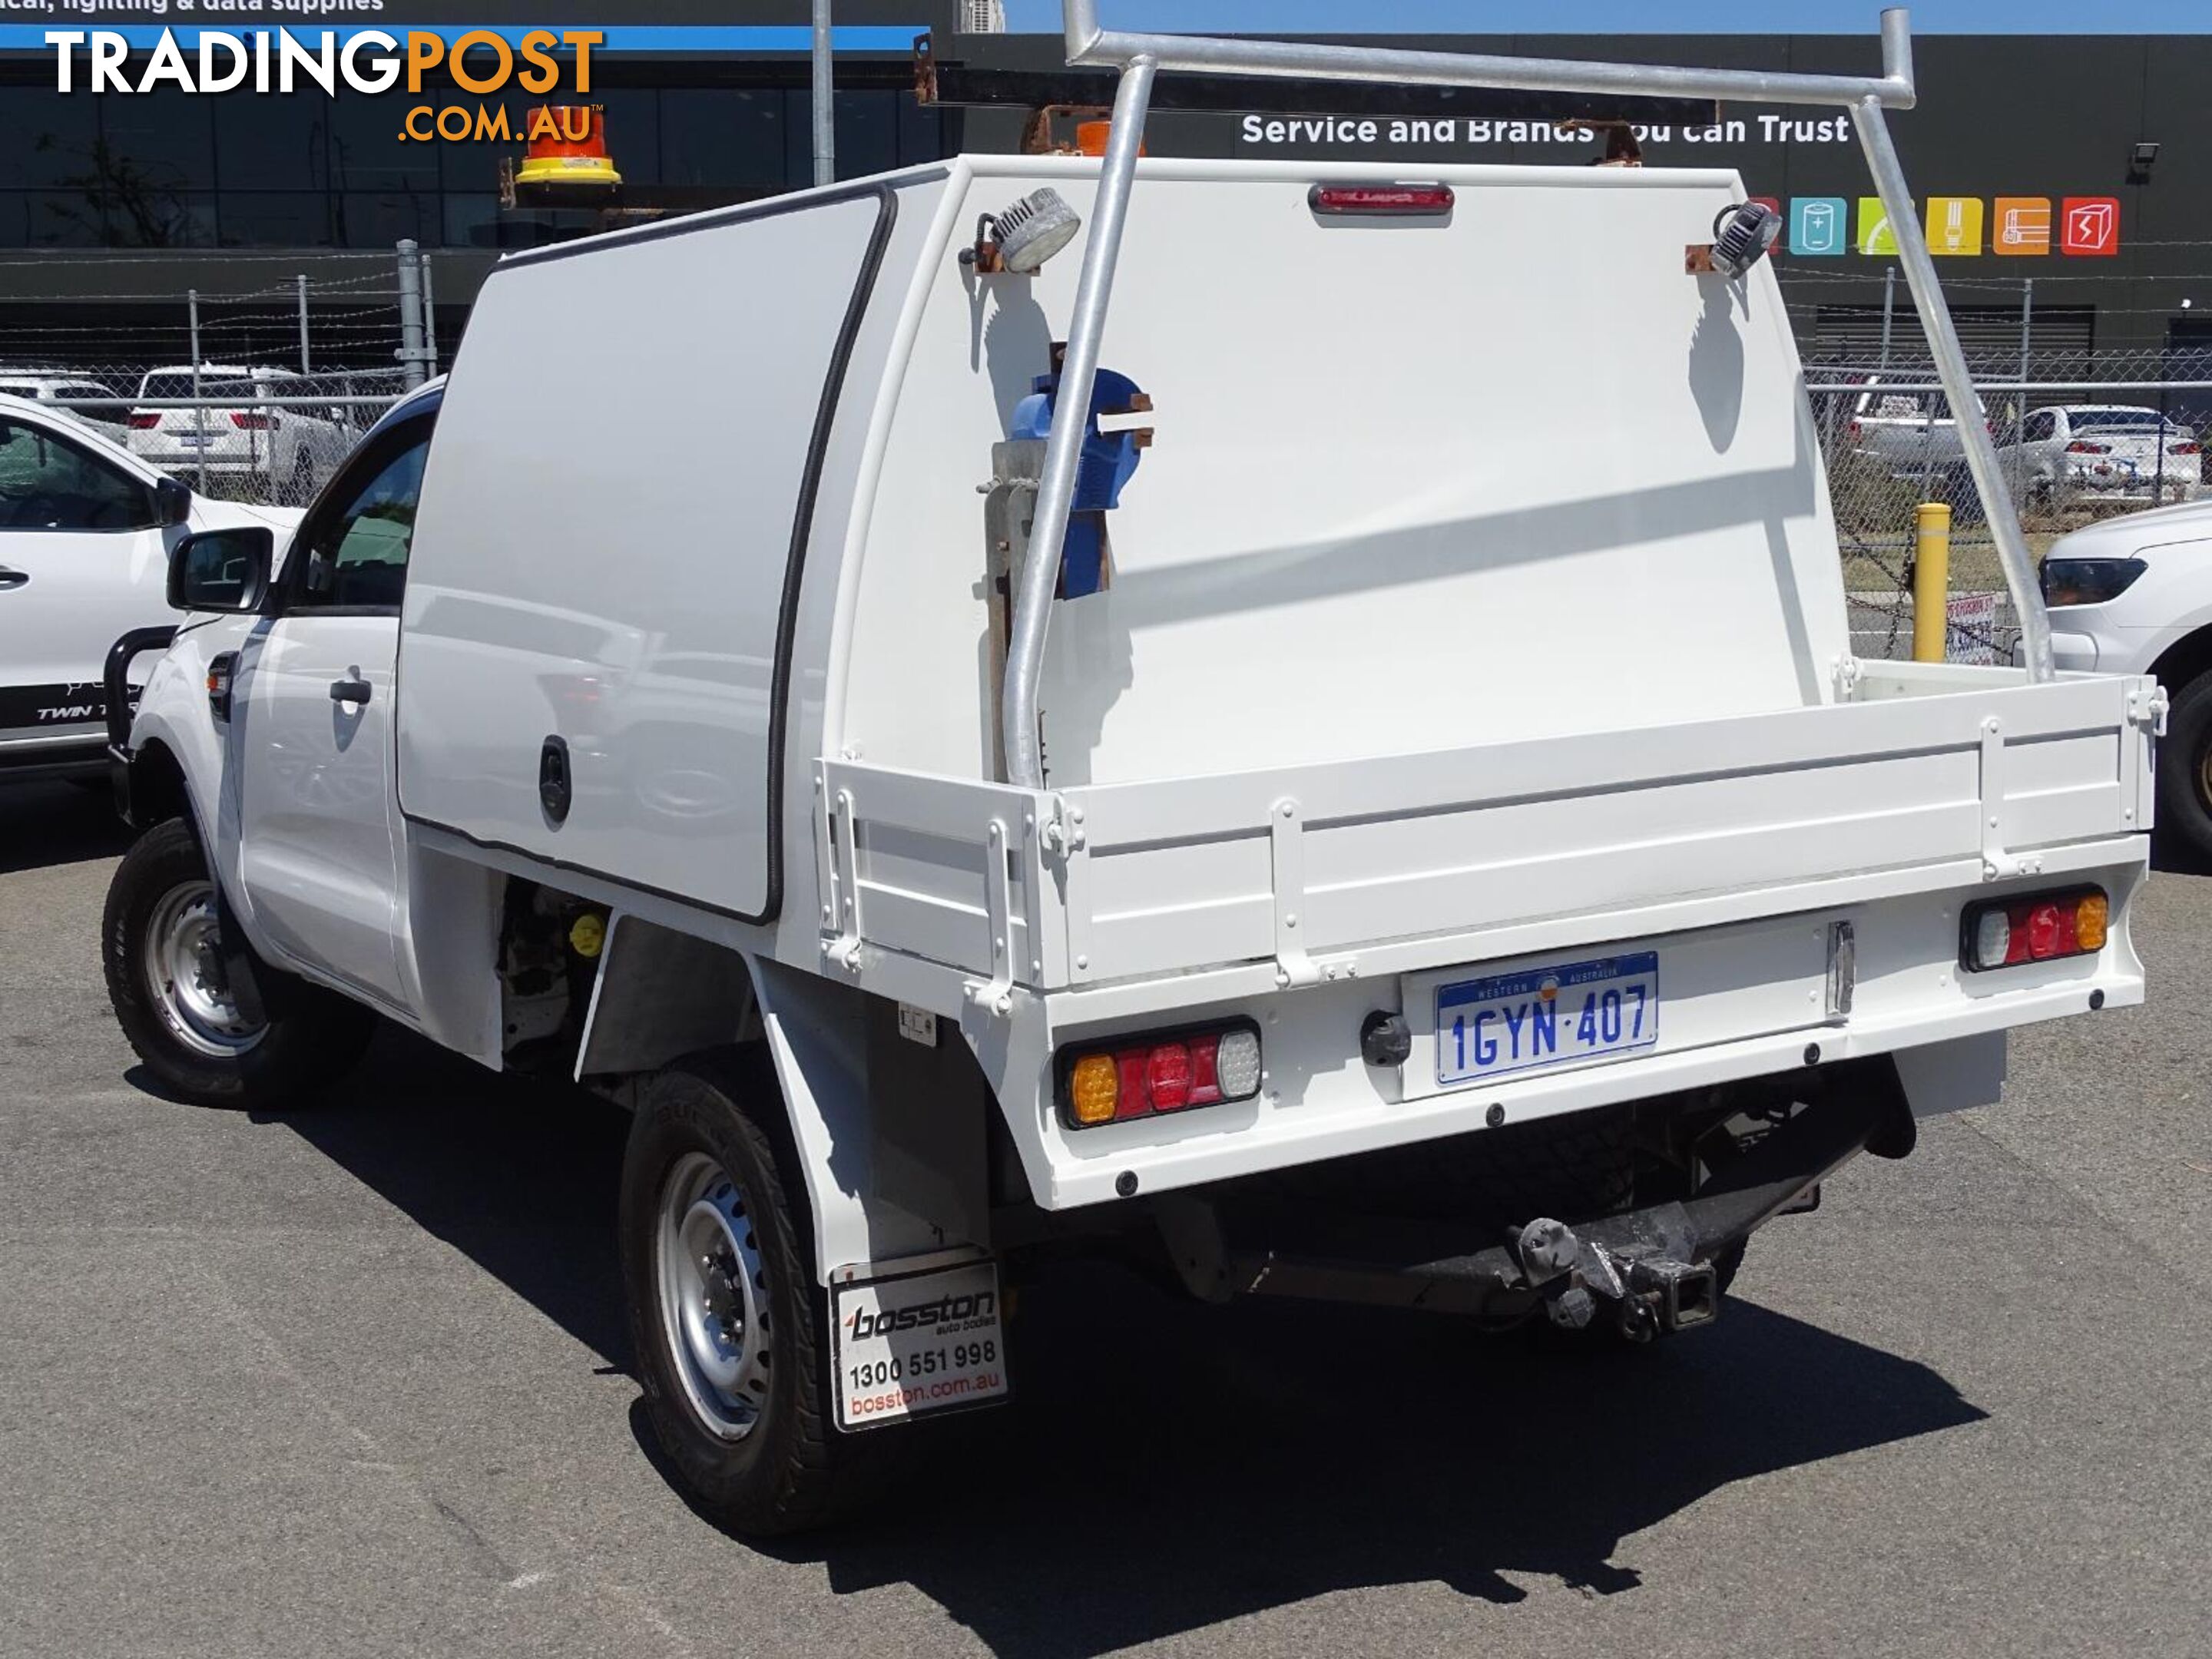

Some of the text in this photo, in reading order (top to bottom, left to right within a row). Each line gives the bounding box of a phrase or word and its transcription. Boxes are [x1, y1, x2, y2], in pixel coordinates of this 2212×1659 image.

[63, 0, 168, 14] lighting
[203, 0, 263, 10] data
[271, 0, 384, 14] supplies
[1242, 114, 1378, 143] Service
[1389, 120, 1455, 143] and
[1682, 121, 1746, 142] can
[1757, 115, 1849, 142] Trust
[38, 705, 93, 720] TWIN
[1478, 968, 1619, 1000] WESTERN AUSTRALIA
[850, 1291, 995, 1342] bosston
[935, 1323, 961, 1336] auto
[849, 1339, 997, 1390] 1300 551 998
[851, 1373, 1001, 1416] bosston.com.au
